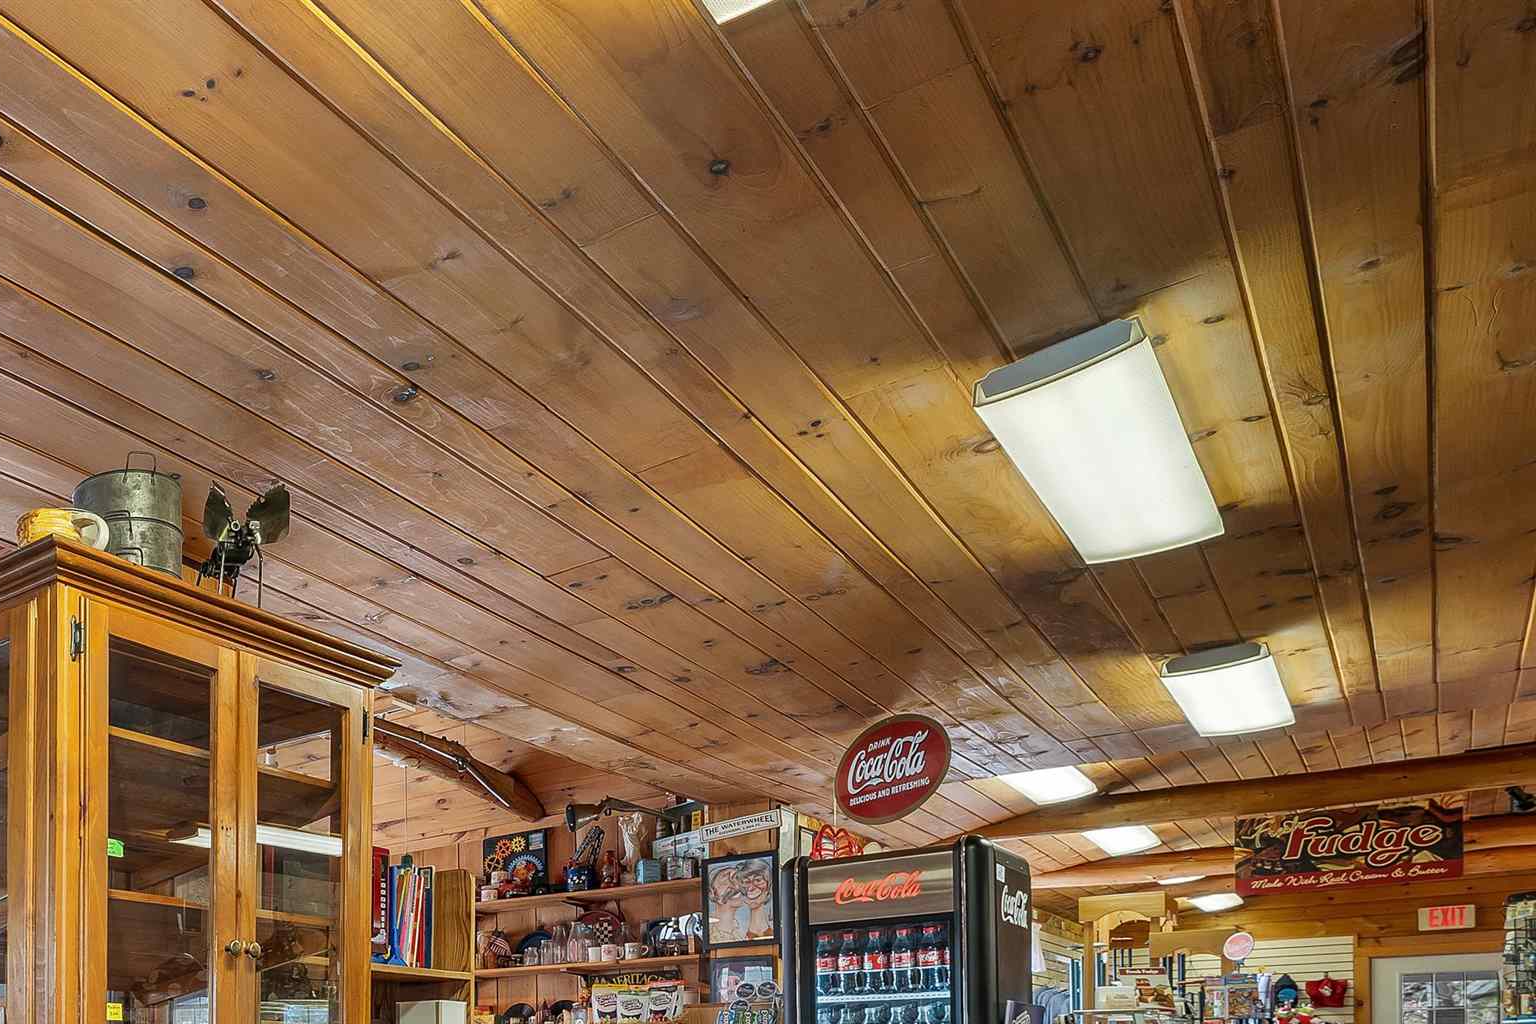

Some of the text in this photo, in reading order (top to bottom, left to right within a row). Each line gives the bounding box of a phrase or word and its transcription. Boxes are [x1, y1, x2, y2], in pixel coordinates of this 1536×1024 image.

[867, 736, 892, 753] DRINK
[847, 729, 929, 795] Coca-Cola
[849, 776, 930, 807] DELICIOUS AND REFRESHING
[704, 826, 720, 837] THE
[721, 814, 776, 831] WATERWHEEL
[1282, 816, 1443, 868] Fudge
[833, 870, 923, 905] Coca-Cola
[1250, 864, 1449, 890] Made With Real Cream & Butter
[1428, 906, 1466, 929] EXIT
